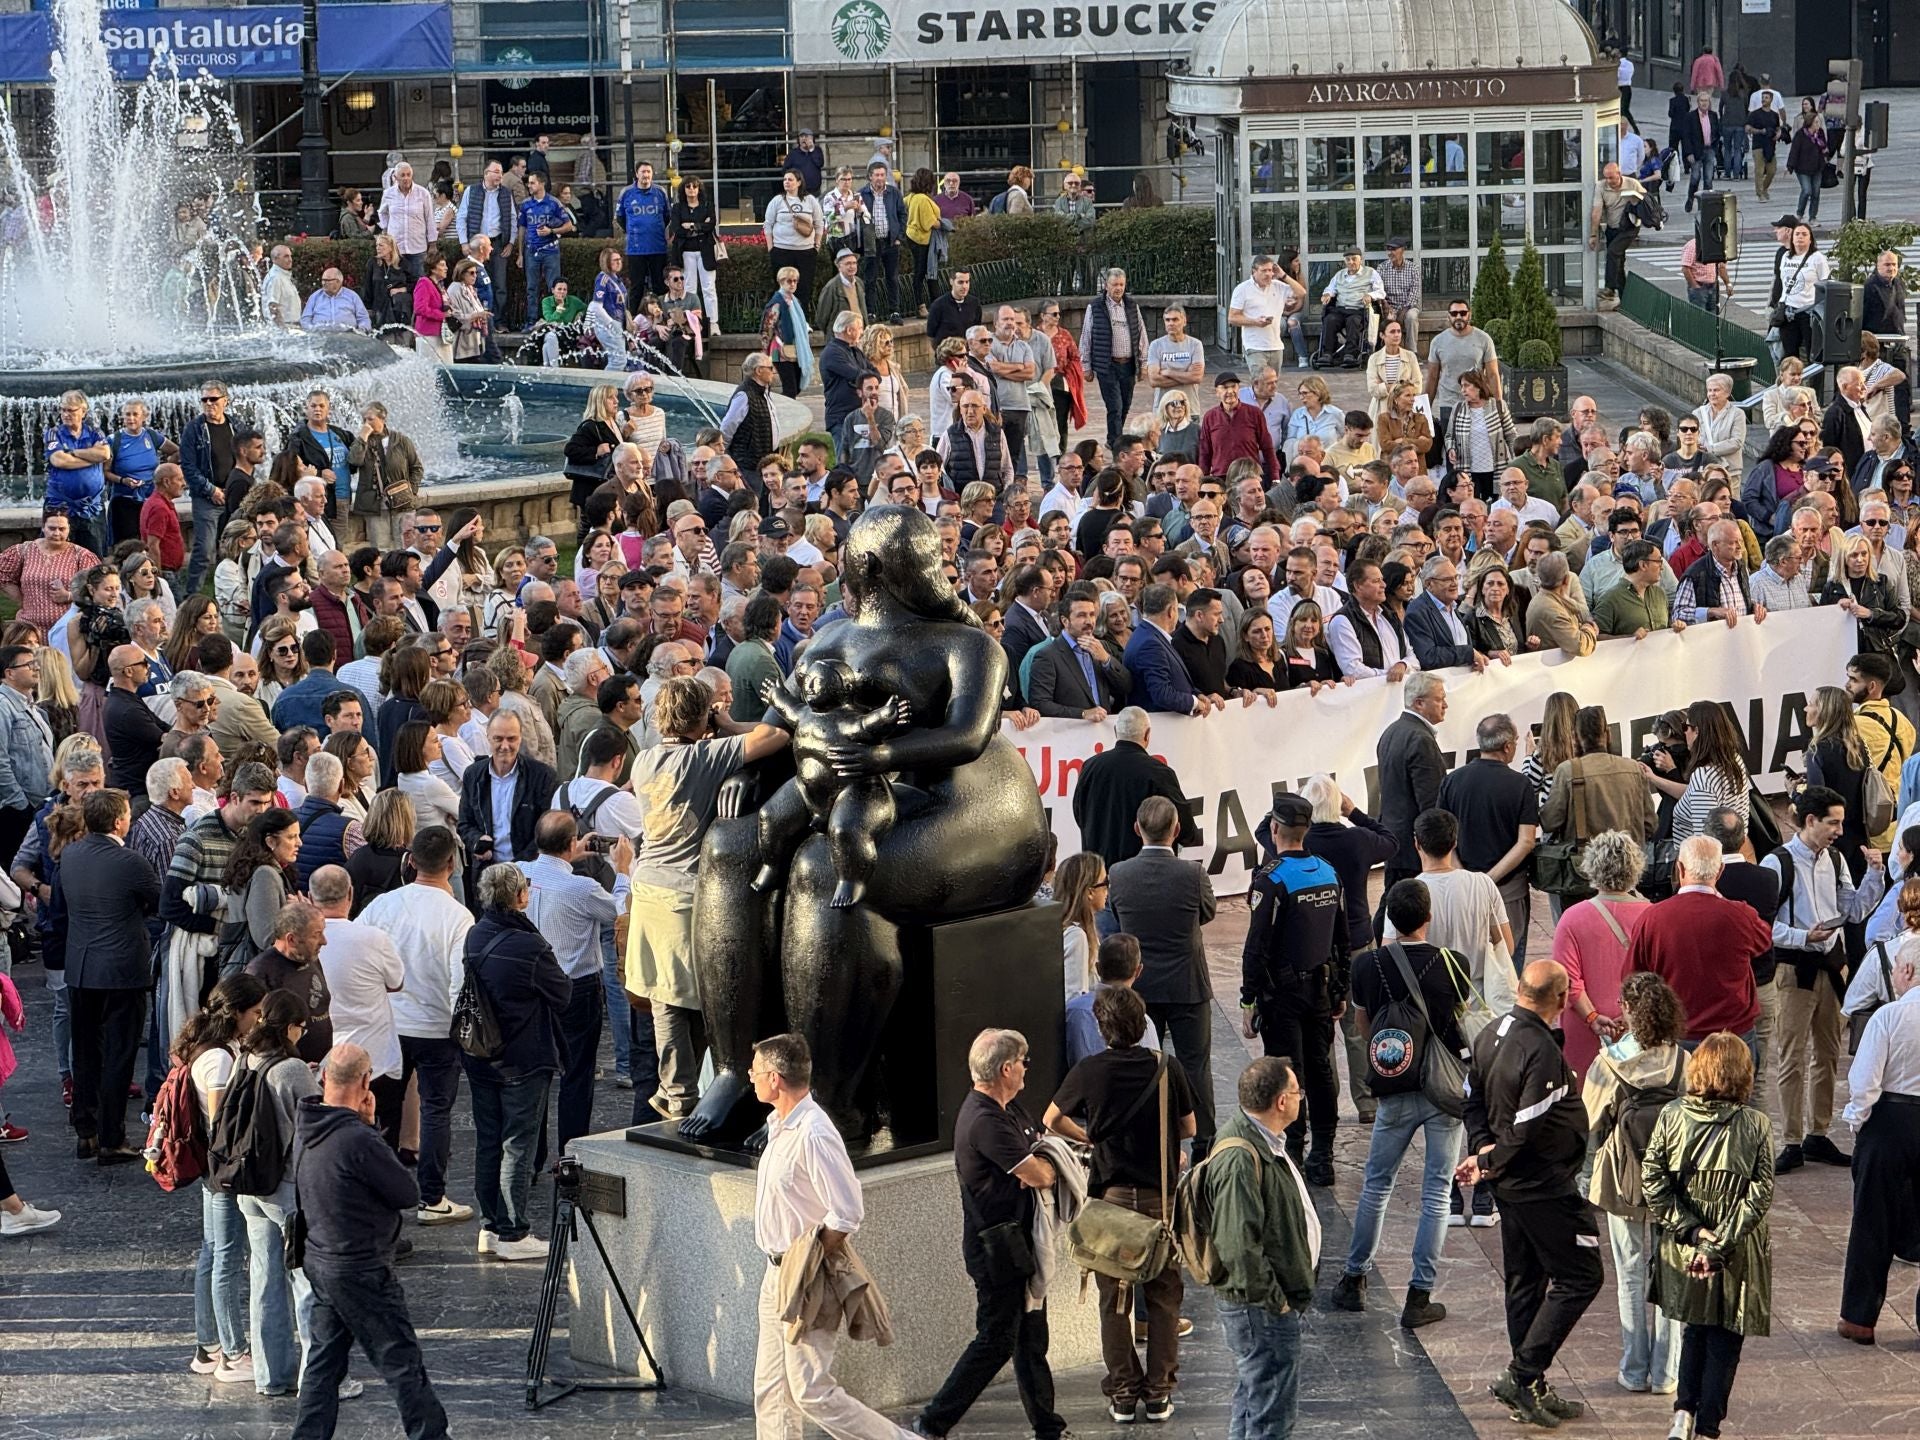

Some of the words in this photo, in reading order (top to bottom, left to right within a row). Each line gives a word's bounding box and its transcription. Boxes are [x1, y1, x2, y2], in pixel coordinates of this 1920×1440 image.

[917, 1, 1217, 44] STARBUCKS
[103, 16, 304, 50] santalucía
[176, 53, 237, 66] SEGUROS
[413, 88, 423, 101] 3
[491, 103, 506, 113] Tu
[507, 102, 551, 113] bebida
[491, 114, 541, 126] favorita
[542, 115, 556, 125] te
[631, 205, 659, 216] DIGI
[1314, 899, 1338, 908] LOCAL
